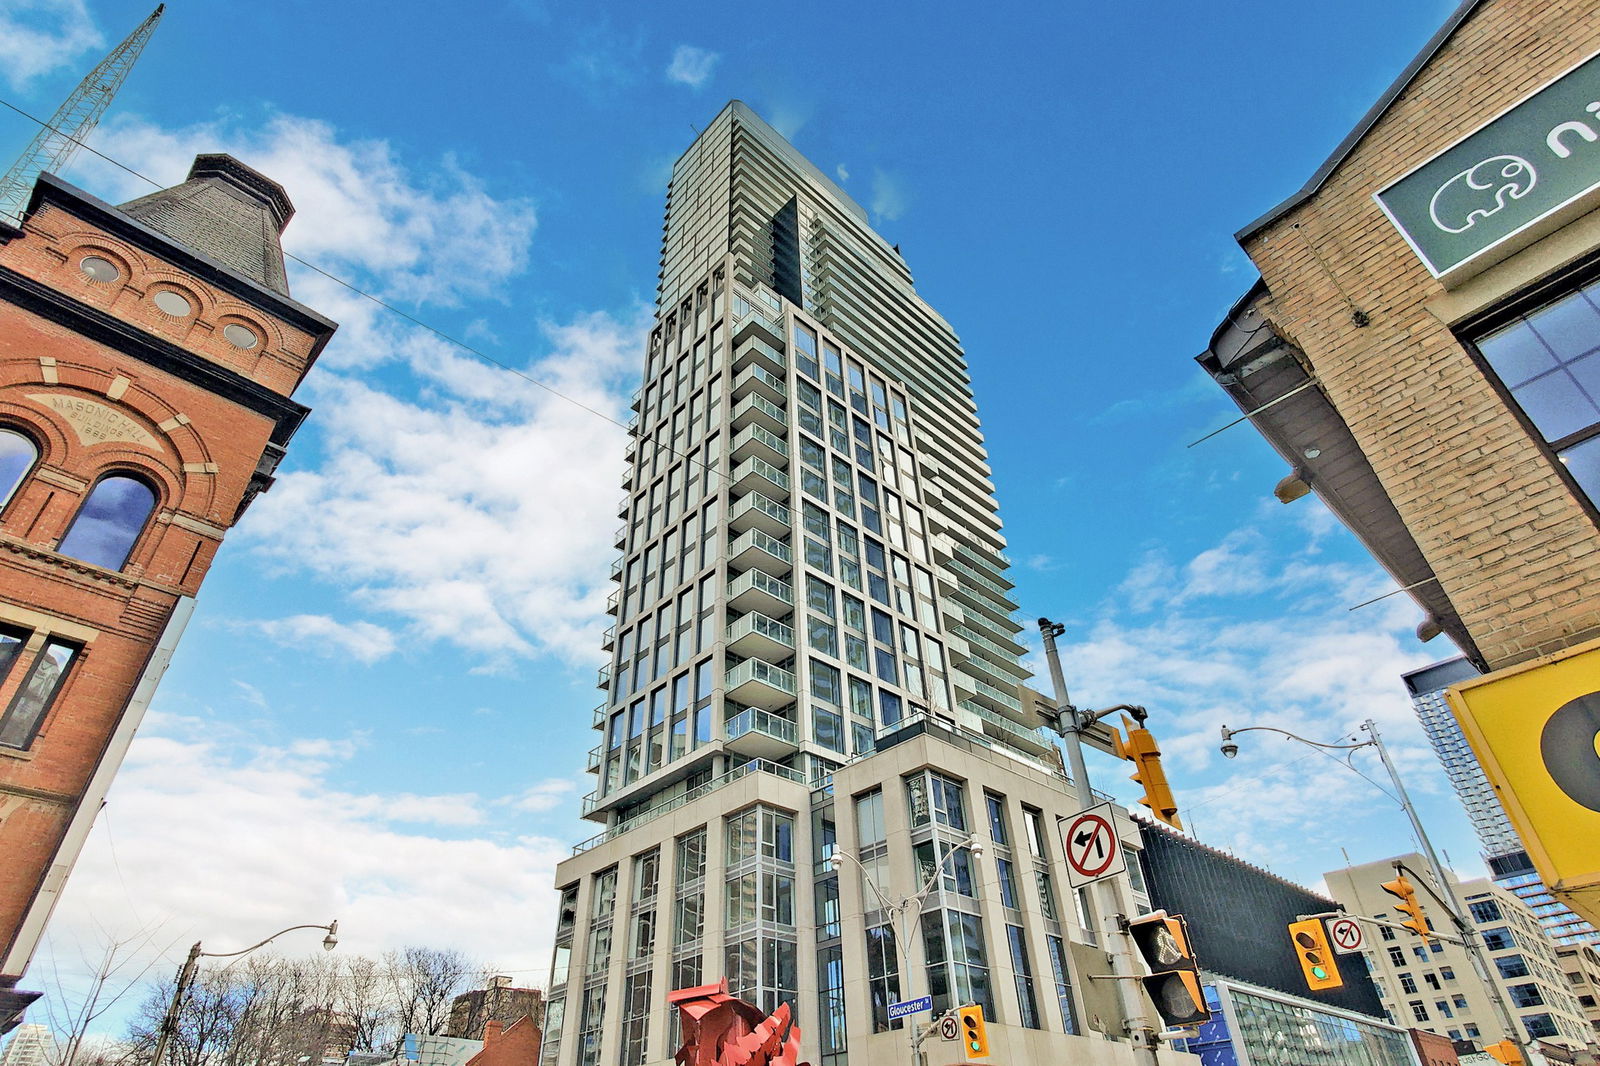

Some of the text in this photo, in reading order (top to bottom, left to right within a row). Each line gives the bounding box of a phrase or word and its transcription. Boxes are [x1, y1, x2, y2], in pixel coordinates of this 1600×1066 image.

[52, 398, 147, 442] MASONIC HALL
[81, 424, 107, 440] 1888
[890, 1001, 924, 1016] Gloucester
